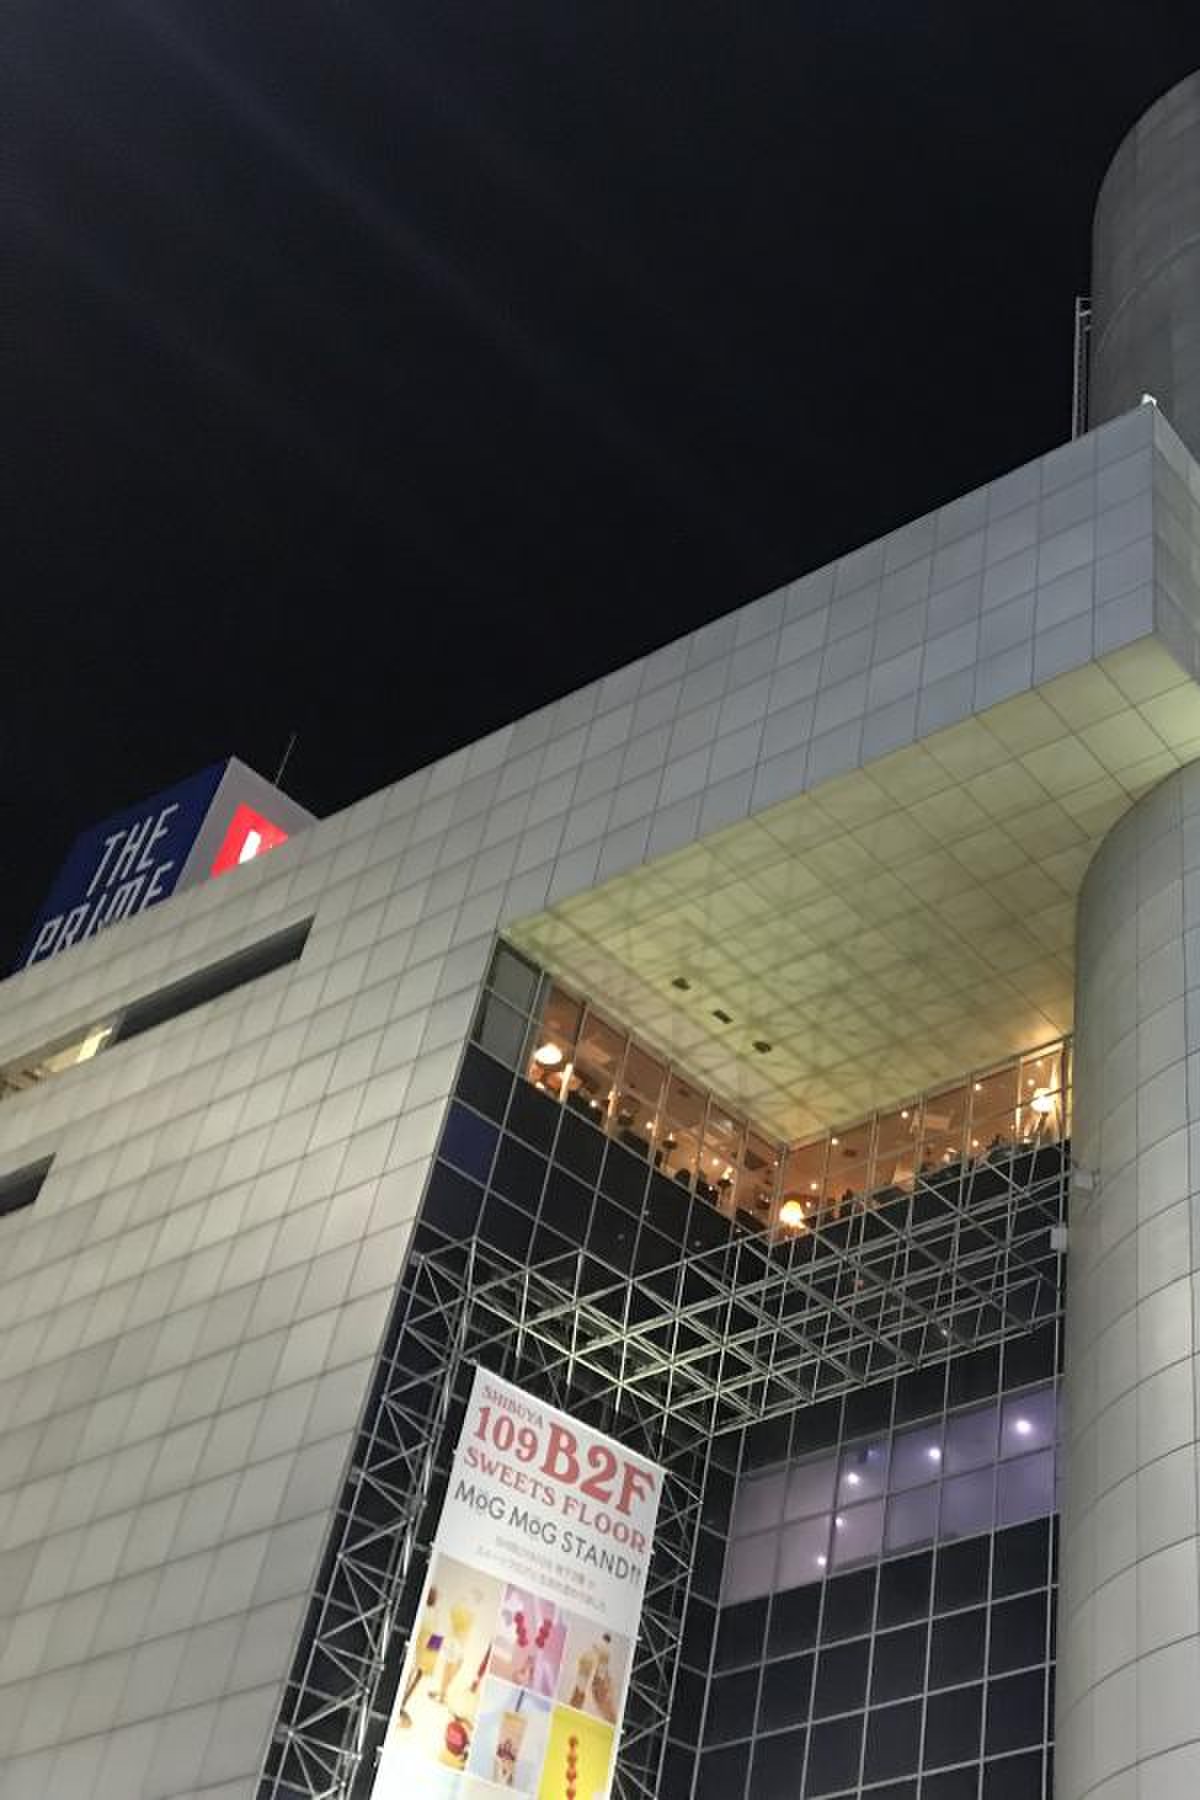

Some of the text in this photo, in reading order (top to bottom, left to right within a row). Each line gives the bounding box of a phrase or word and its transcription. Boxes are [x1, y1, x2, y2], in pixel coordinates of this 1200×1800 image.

[86, 802, 179, 897] THE
[27, 861, 174, 966] PRIME
[481, 1384, 544, 1429] SHIBUYA
[464, 1446, 647, 1553] SWEETS FLOOR
[473, 1406, 656, 1516] 109 B2F
